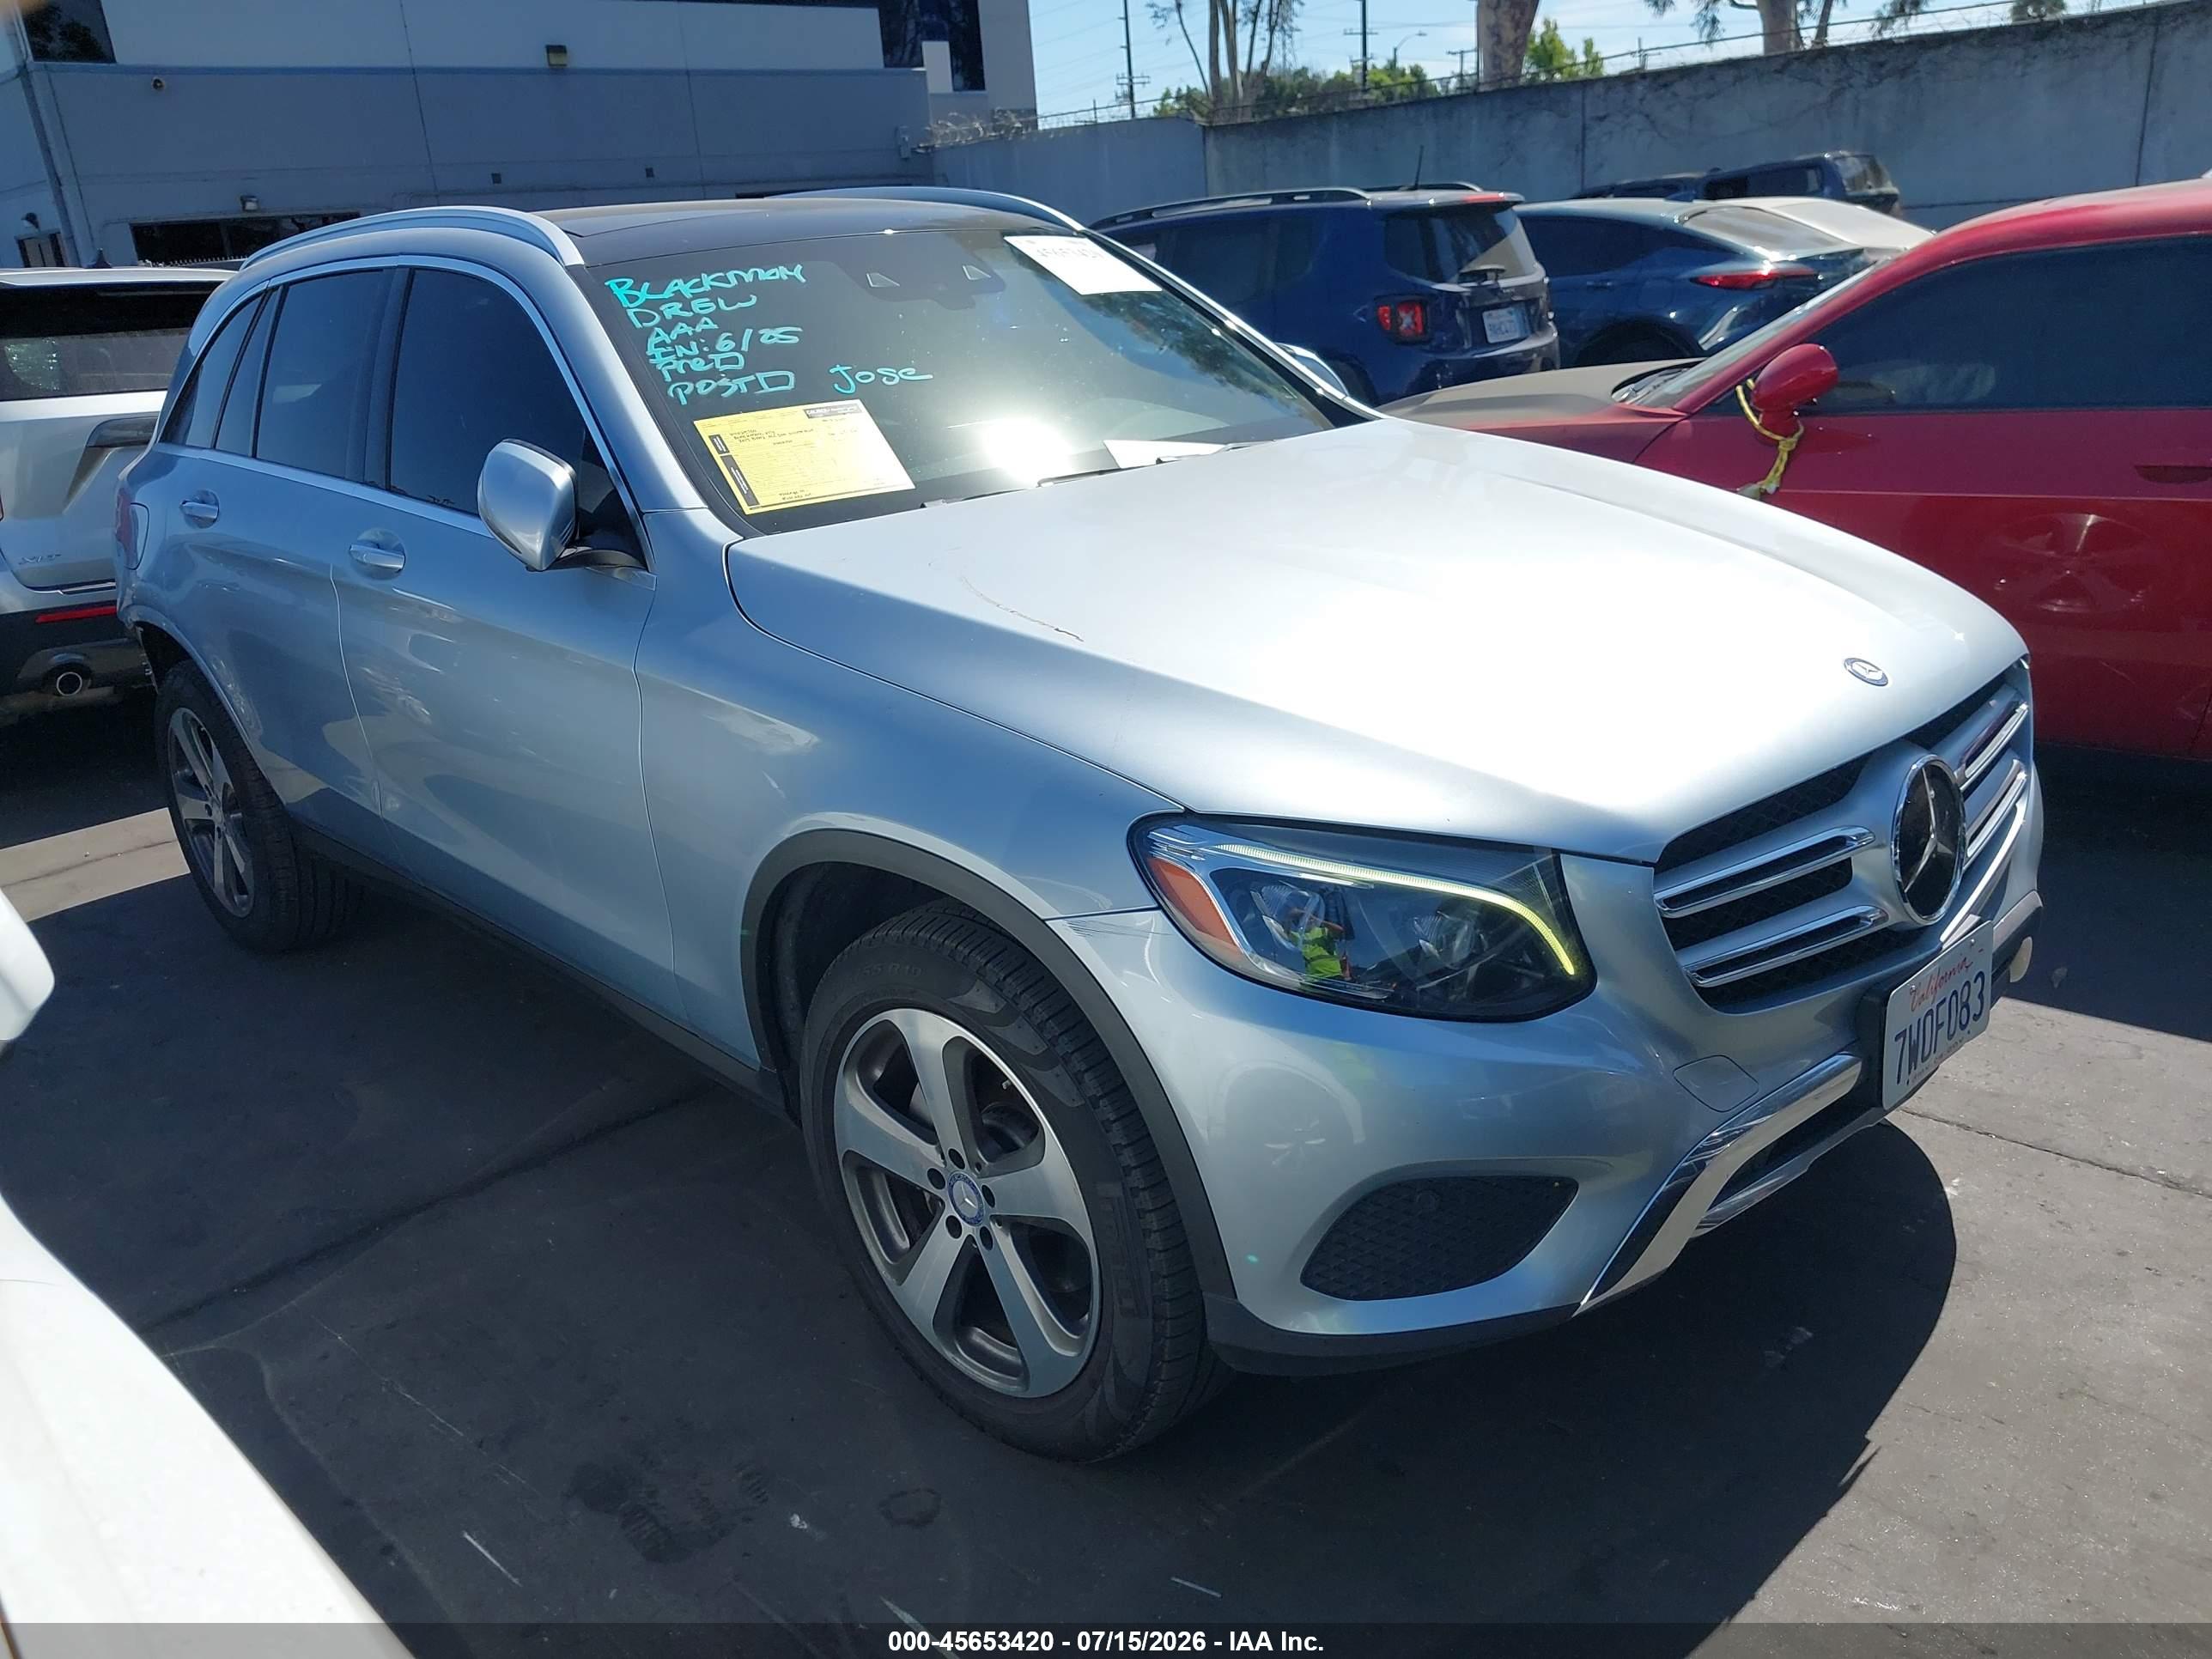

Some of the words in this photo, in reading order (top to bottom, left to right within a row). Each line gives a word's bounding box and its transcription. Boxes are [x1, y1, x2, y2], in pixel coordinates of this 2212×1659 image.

[626, 295, 757, 328] DREW
[647, 317, 718, 354] AAA
[830, 364, 933, 394] Jose
[1910, 956, 1974, 1012] California
